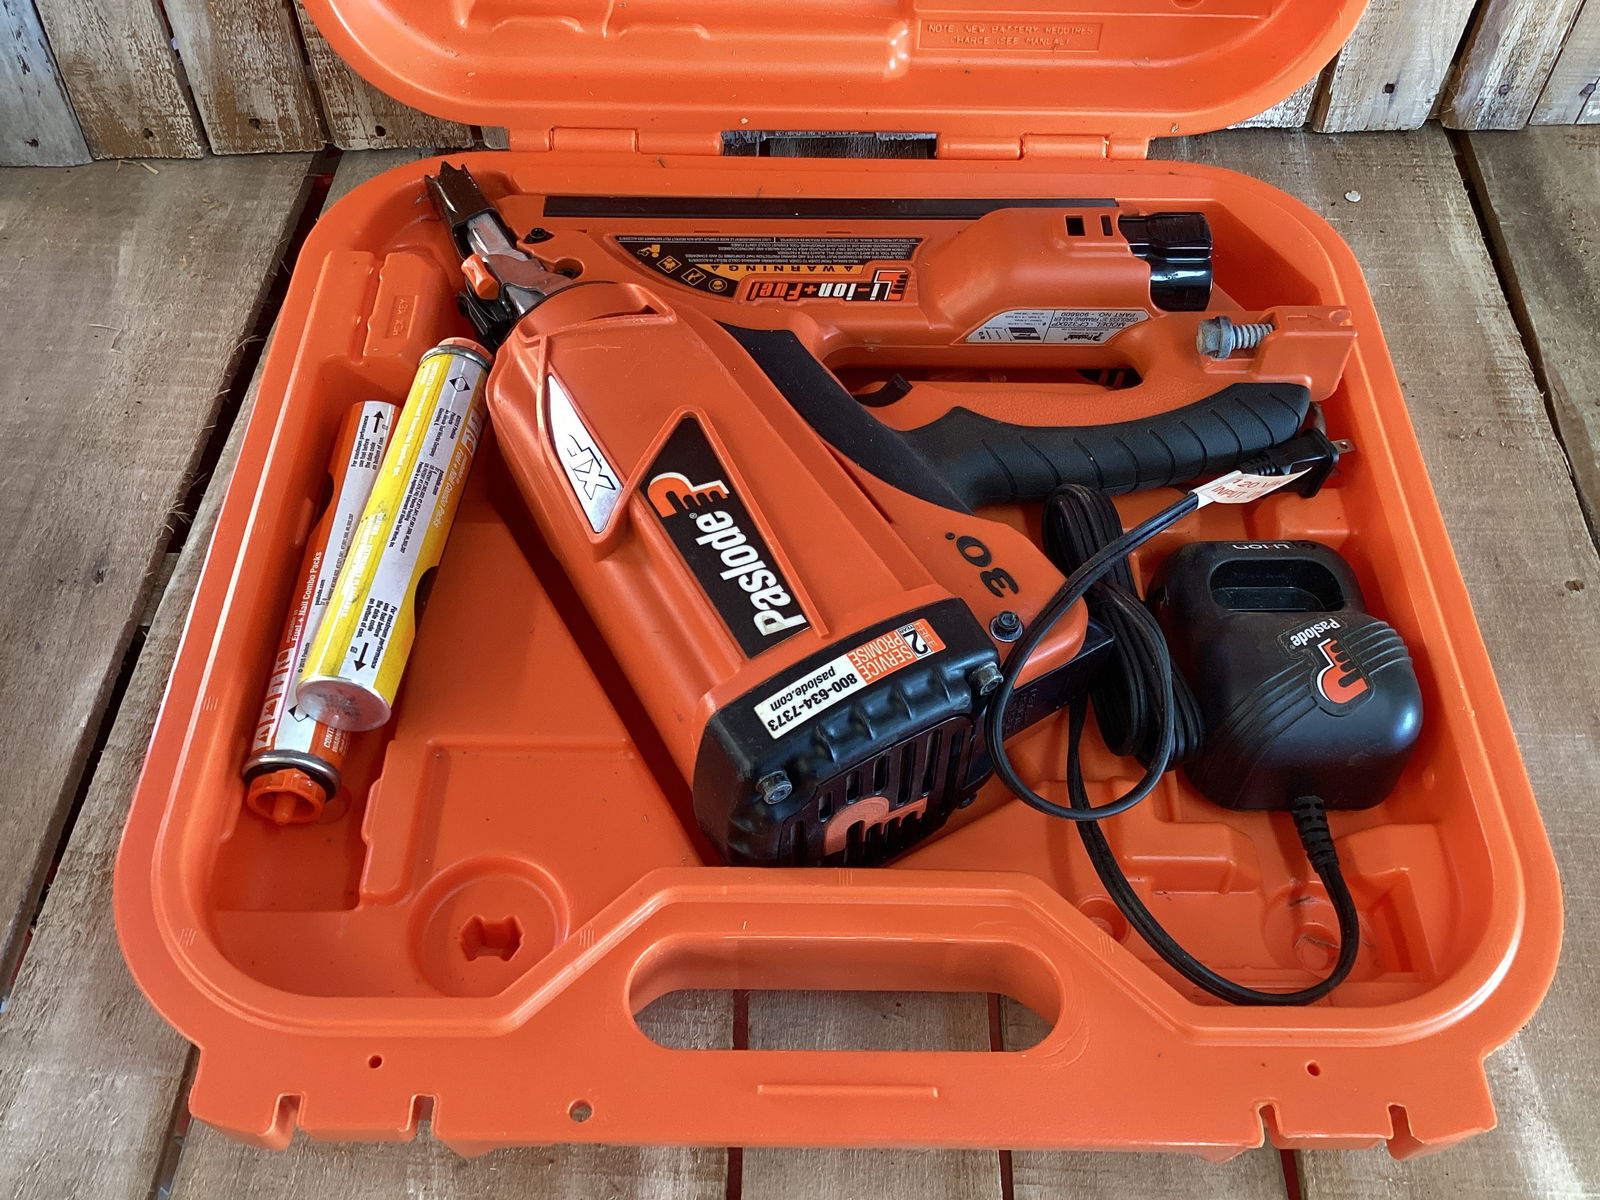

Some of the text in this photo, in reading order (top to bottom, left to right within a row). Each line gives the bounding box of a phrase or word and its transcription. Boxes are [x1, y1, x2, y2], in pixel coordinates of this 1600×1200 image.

[309, 550, 323, 573] Packs
[302, 573, 317, 600] Combo
[297, 599, 309, 616] Nail
[362, 604, 373, 622] bottom
[368, 597, 375, 605] on
[367, 599, 383, 632] the date code
[373, 602, 390, 637] use fuel before
[290, 623, 302, 642] Fuel
[355, 627, 364, 639] can.
[368, 605, 397, 669] For maximum performance
[902, 629, 928, 654] 2
[847, 630, 903, 667] PROMISE
[857, 643, 912, 680] SERVICE
[766, 672, 858, 732] 800-634-7373
[768, 666, 836, 712] paslode.com
